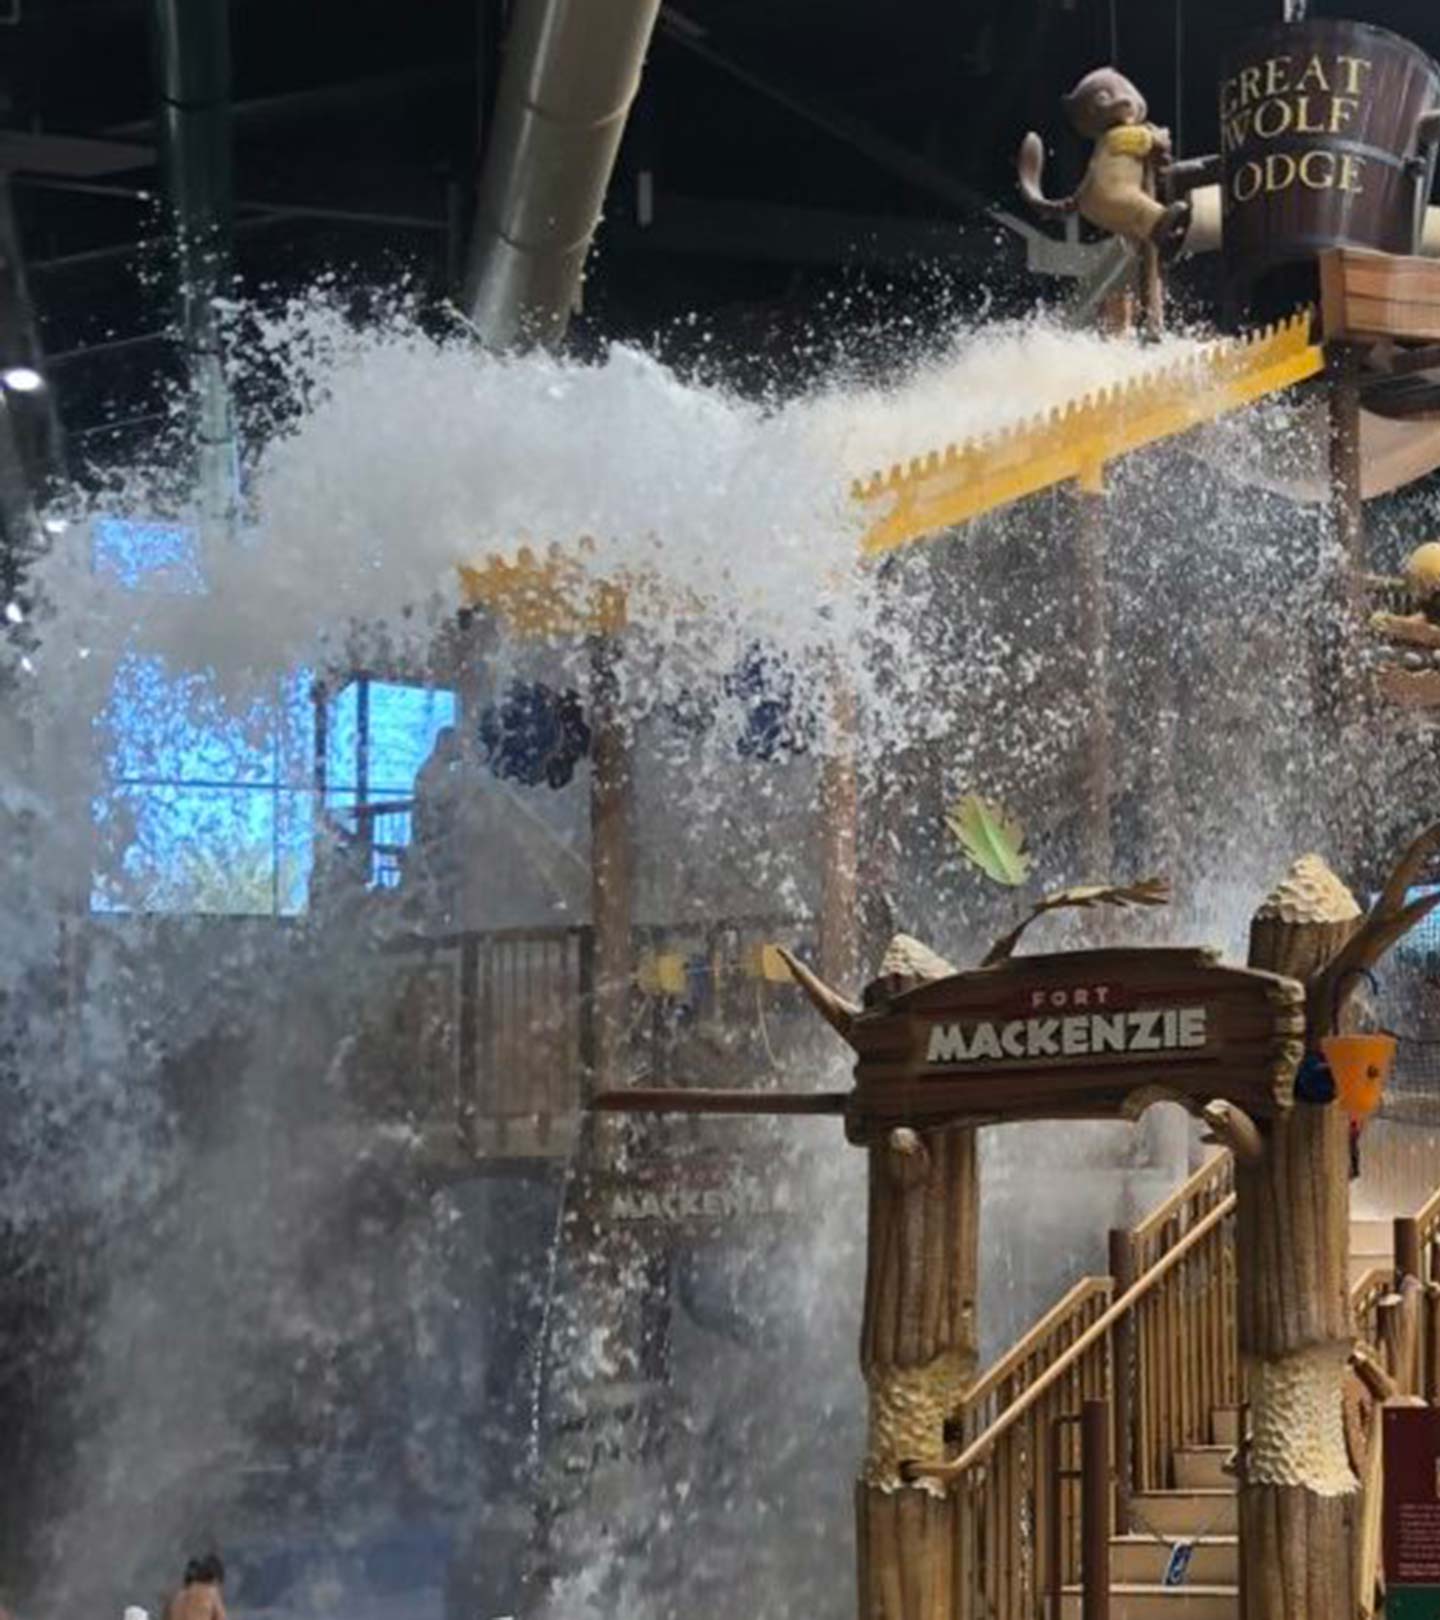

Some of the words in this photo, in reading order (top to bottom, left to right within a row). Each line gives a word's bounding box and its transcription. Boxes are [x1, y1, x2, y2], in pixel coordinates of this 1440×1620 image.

[1219, 53, 1372, 115] GREAT
[1220, 96, 1359, 151] WOLF
[1232, 150, 1367, 202] ODGE
[1033, 986, 1110, 1008] FORT
[926, 1008, 1207, 1062] MACKENZIE
[611, 1190, 786, 1220] MACKEN
